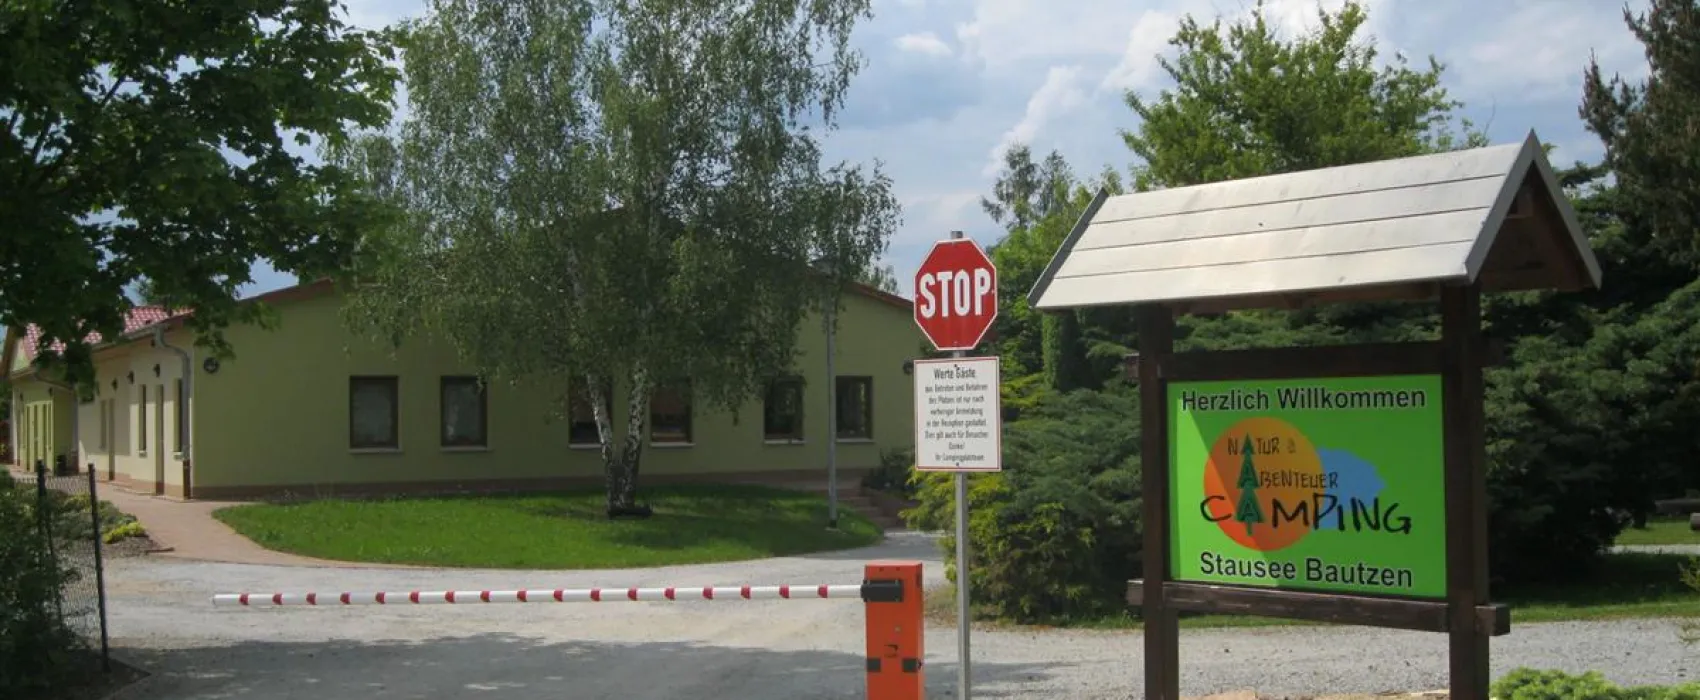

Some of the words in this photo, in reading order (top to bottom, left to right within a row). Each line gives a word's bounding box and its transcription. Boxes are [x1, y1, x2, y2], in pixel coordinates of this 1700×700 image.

[920, 268, 991, 318] STOP
[934, 368, 954, 380] Werte
[1181, 389, 1270, 411] Herzlich
[1276, 387, 1426, 410] Willkommen
[1200, 551, 1297, 579] Stausee
[1305, 557, 1412, 586] Bautzen
